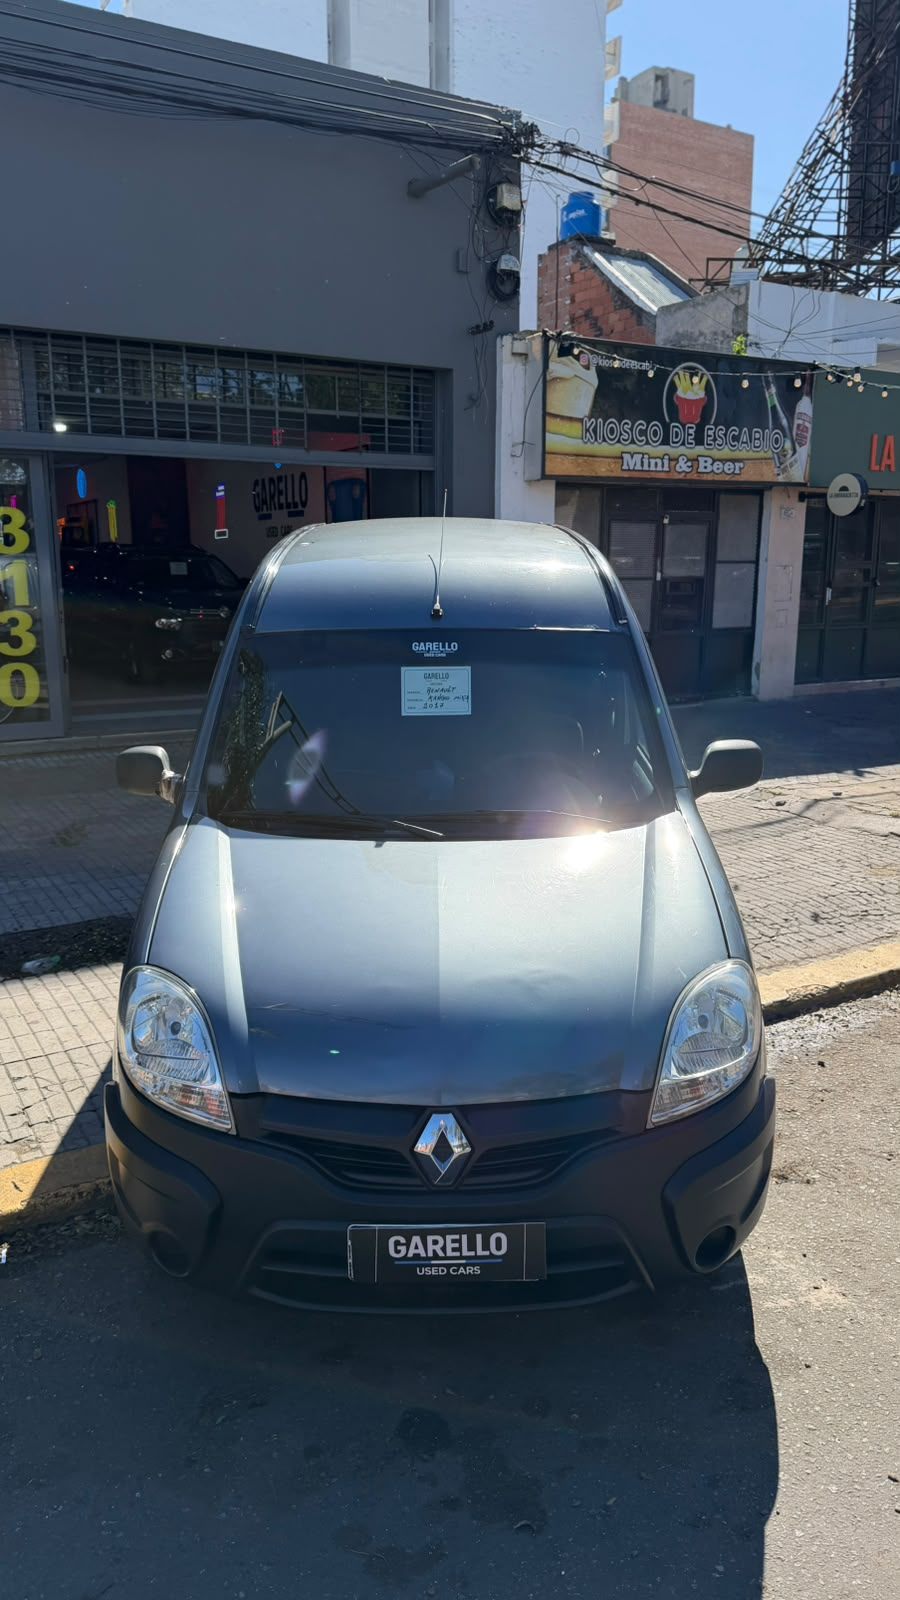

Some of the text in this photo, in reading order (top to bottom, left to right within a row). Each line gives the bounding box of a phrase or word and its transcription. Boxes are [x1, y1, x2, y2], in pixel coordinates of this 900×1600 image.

[582, 417, 663, 446] KIOSCO
[669, 422, 696, 448] DE
[704, 425, 784, 453] ESCABIO
[621, 452, 745, 475] Mini & Beer
[869, 432, 896, 473] LA
[252, 471, 308, 513] GARELLO
[412, 642, 458, 651] GARELLO
[423, 672, 450, 680] GARELLO
[388, 1232, 508, 1258] GARELLO
[416, 1266, 481, 1275] USED CARS
